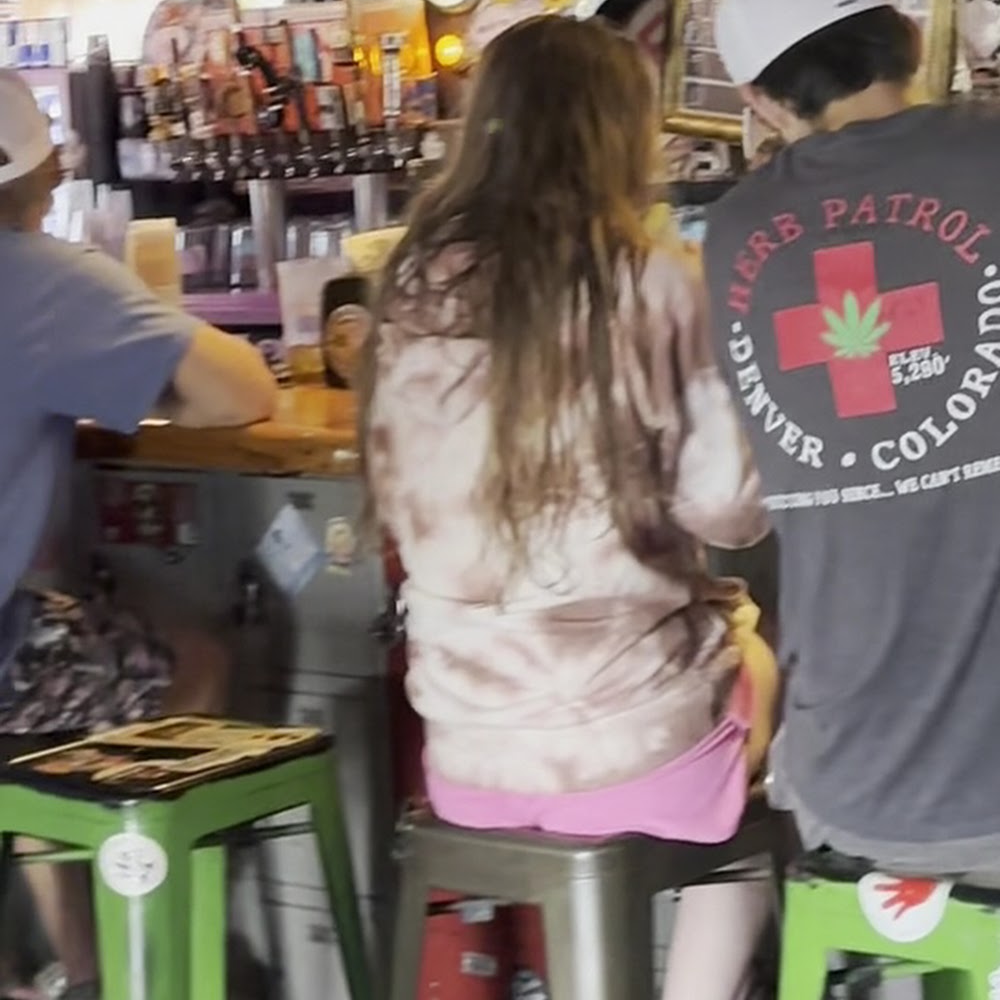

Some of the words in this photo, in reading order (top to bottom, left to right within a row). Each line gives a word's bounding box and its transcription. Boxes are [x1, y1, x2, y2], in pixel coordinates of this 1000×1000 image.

[728, 212, 804, 315] HERB
[822, 193, 992, 264] PATROL
[728, 334, 823, 468] DENVER
[895, 474, 920, 495] WE
